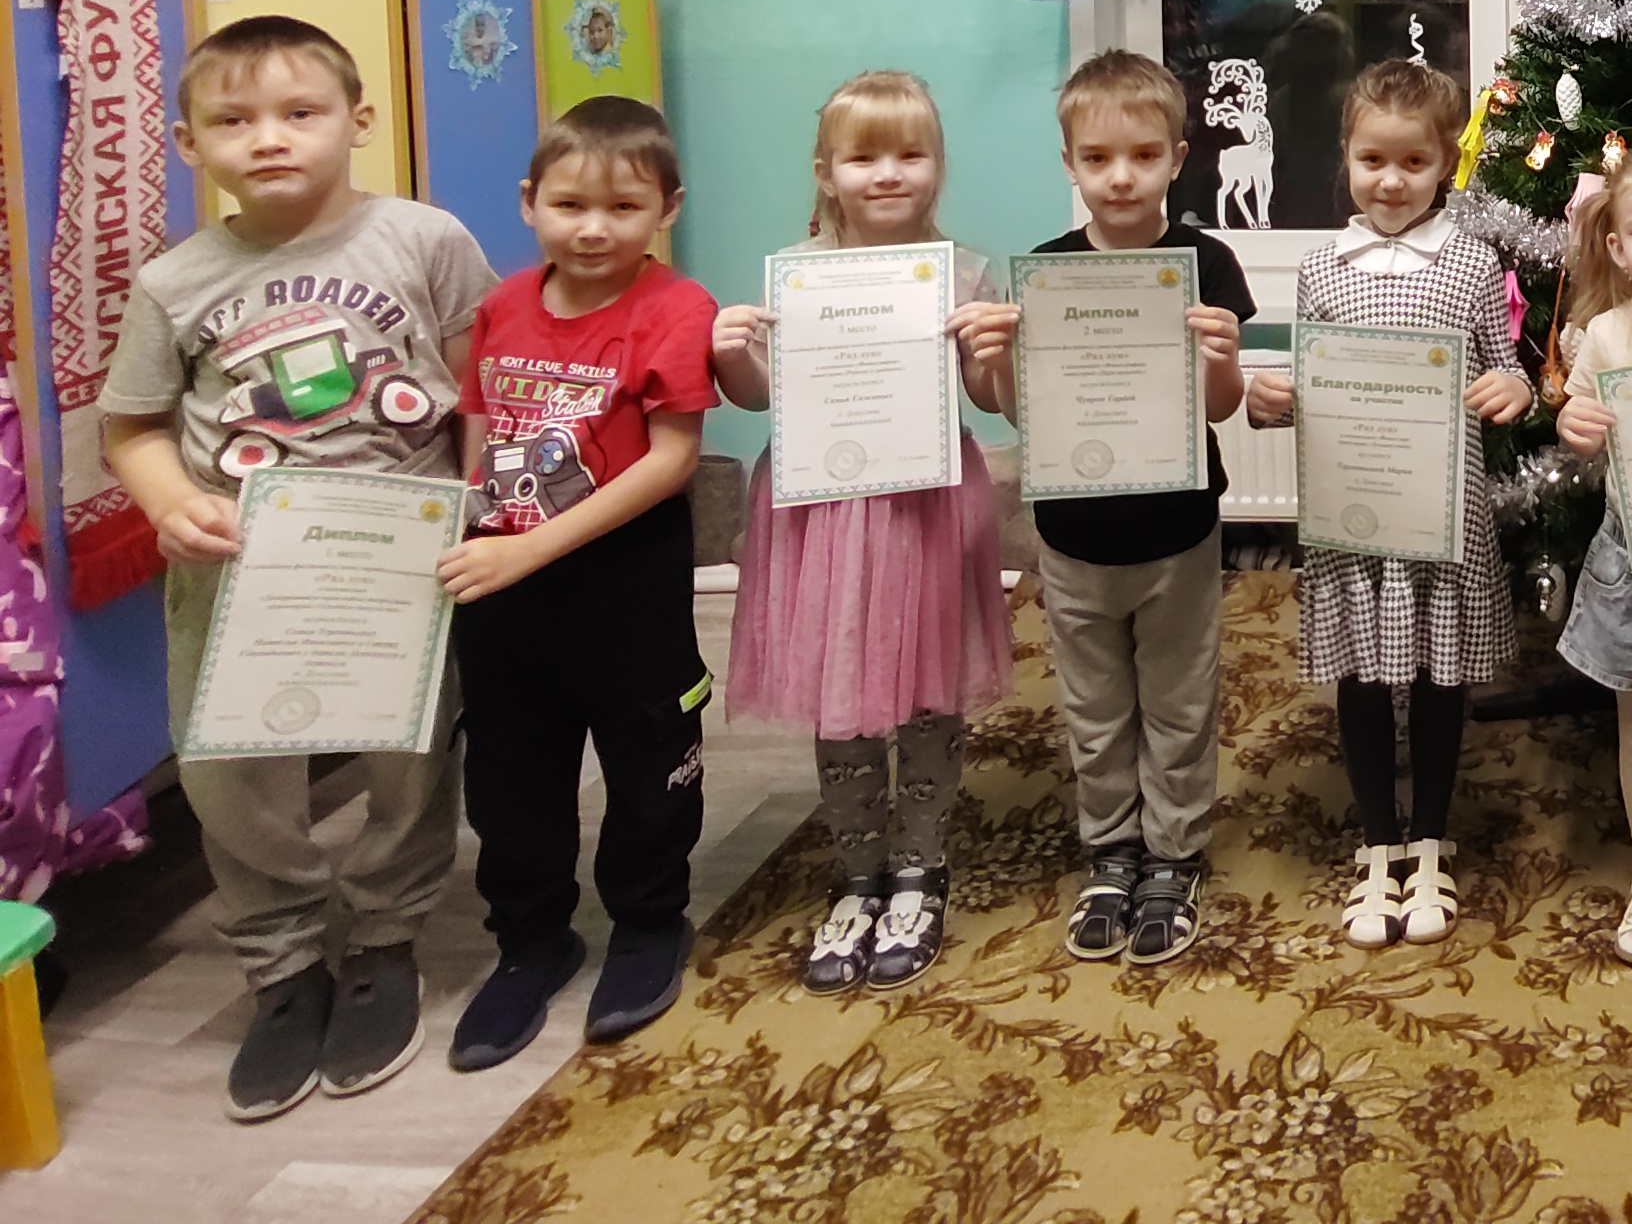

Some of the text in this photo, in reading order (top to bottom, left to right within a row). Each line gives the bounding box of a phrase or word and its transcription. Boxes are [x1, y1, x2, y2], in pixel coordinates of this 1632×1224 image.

[264, 275, 409, 334] ROADER
[820, 303, 894, 321] Диплом
[1064, 306, 1139, 322] Диплом
[847, 324, 877, 334] место
[1093, 327, 1123, 335] место
[500, 356, 526, 368] NEXT
[1311, 375, 1444, 396] Благодарность
[302, 526, 394, 545] Диплом
